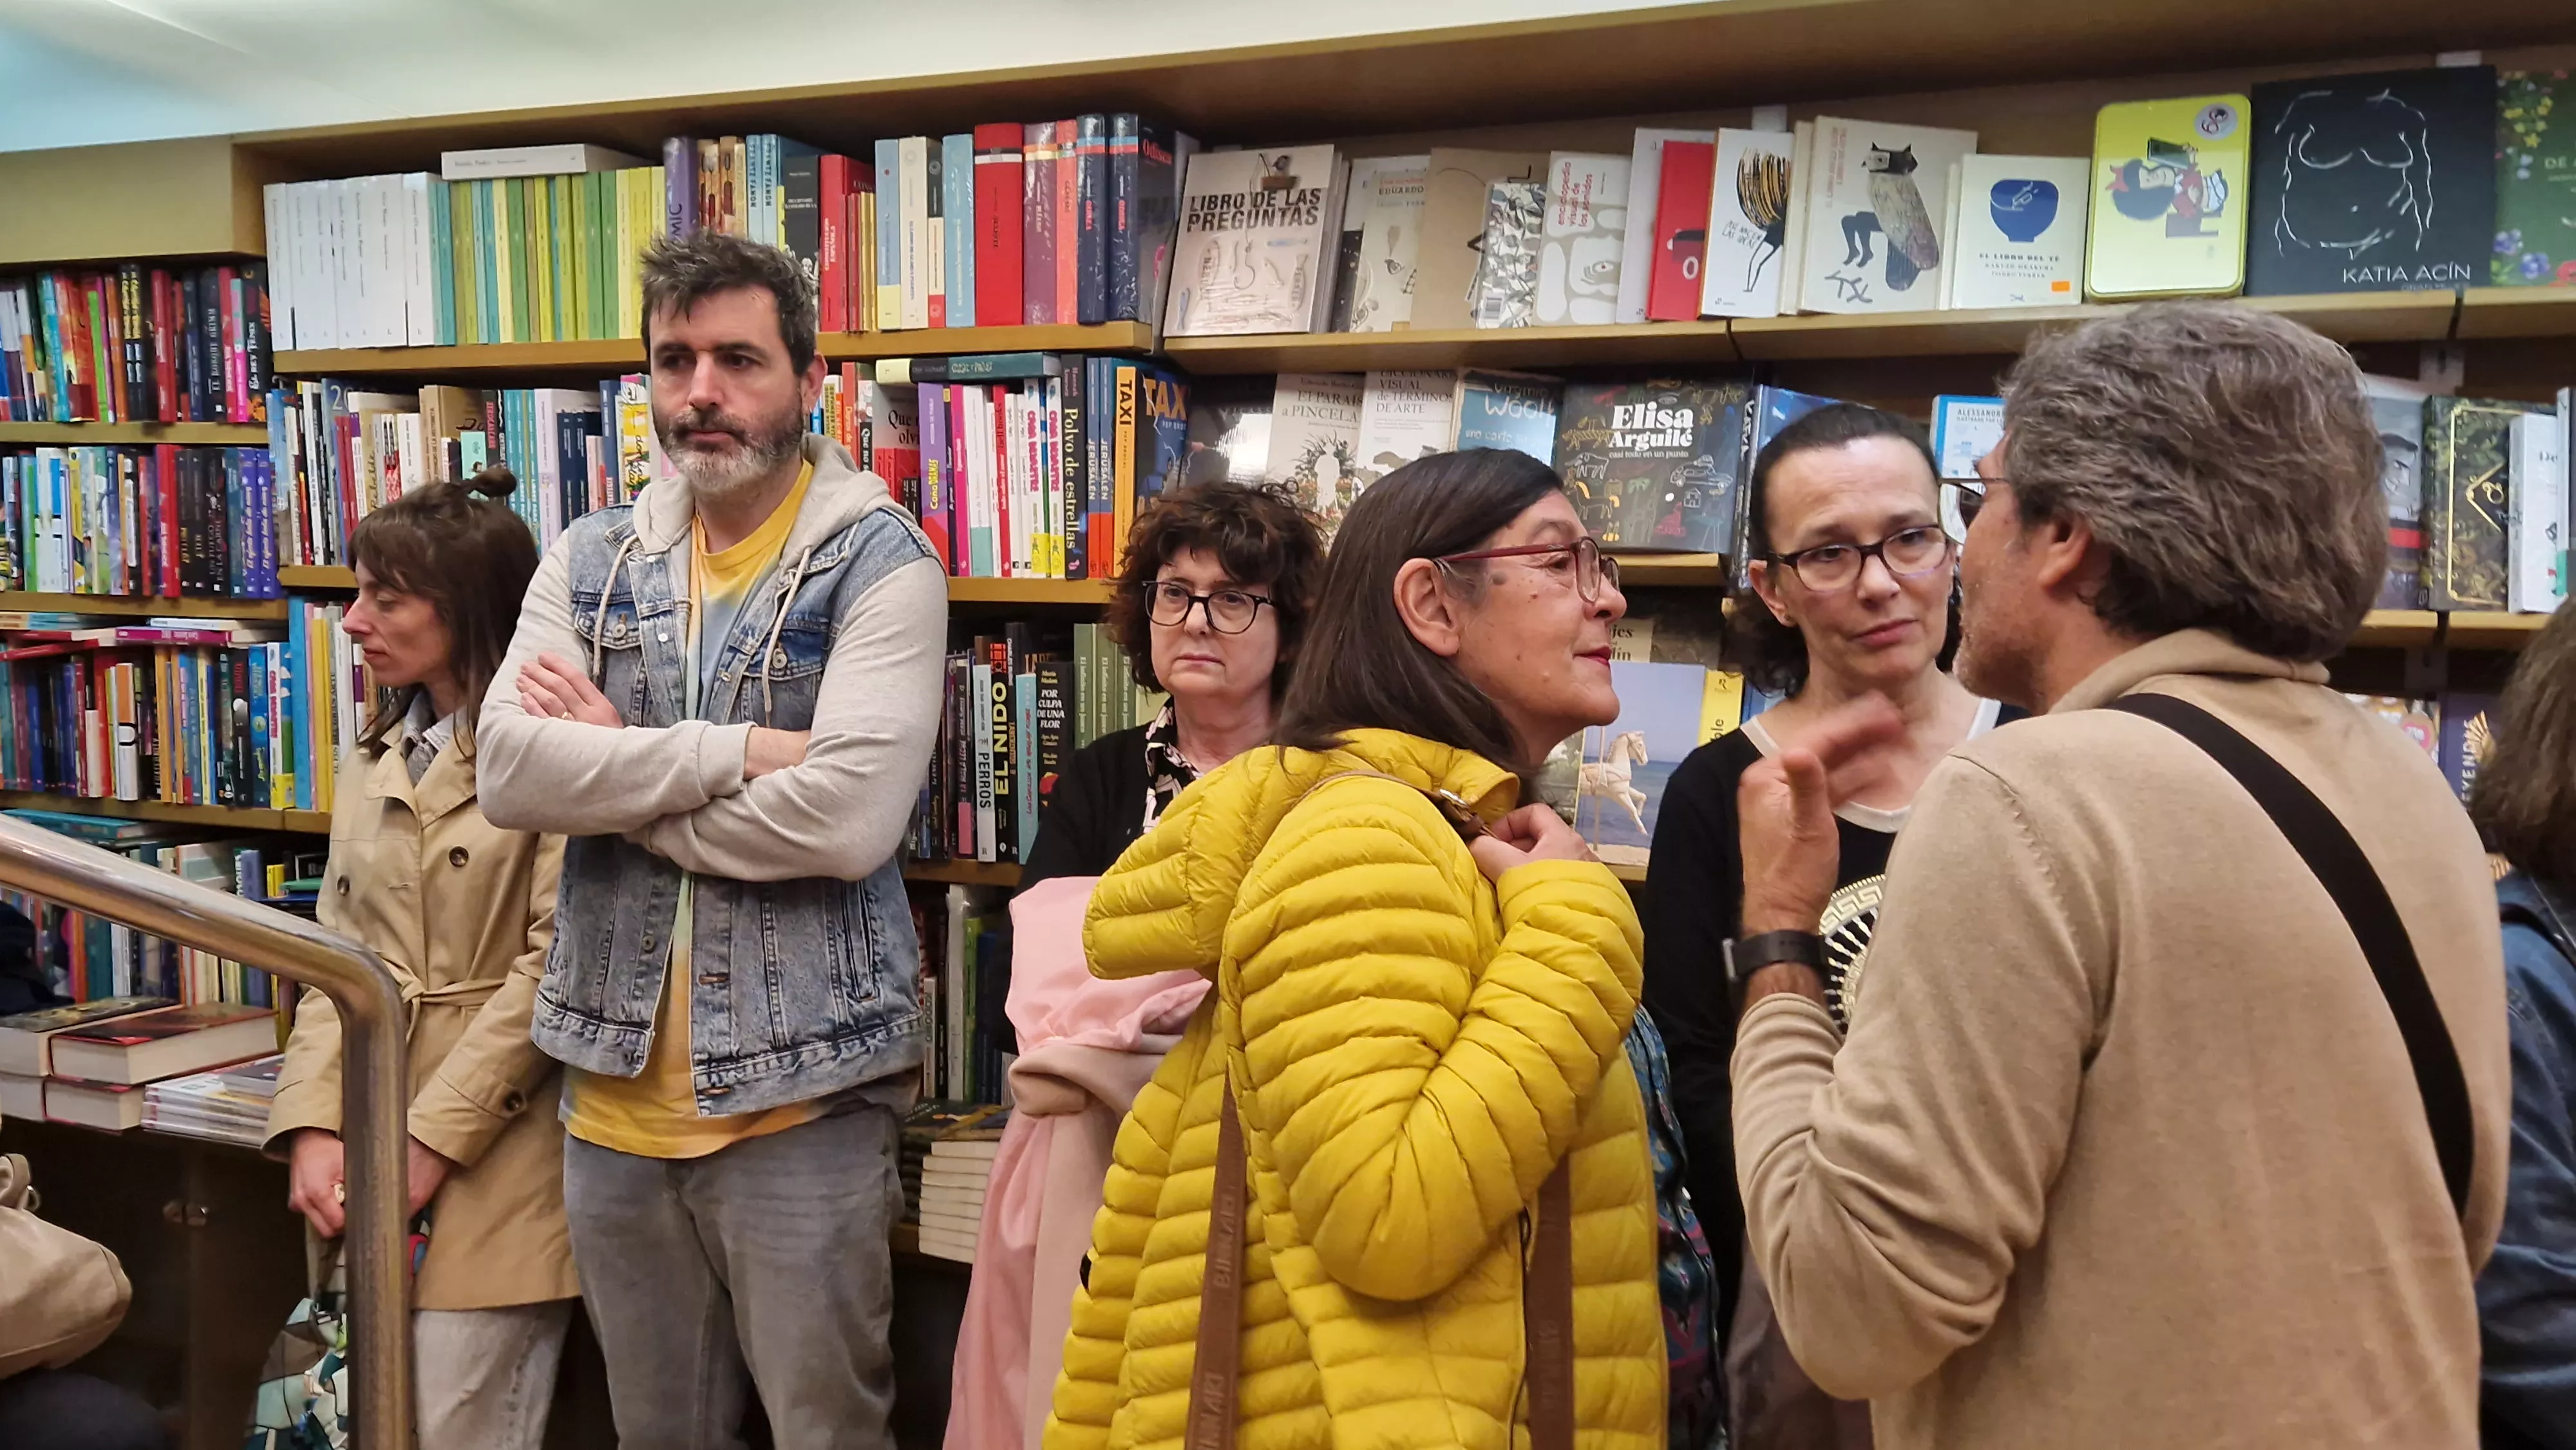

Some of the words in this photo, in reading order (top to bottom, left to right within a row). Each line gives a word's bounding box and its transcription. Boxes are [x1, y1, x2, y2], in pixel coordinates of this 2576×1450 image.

[749, 180, 758, 208] FANON
[764, 178, 773, 207] FANON
[1189, 193, 1246, 212] LIBRO
[1252, 191, 1277, 209] DE
[1284, 188, 1322, 207] LAS
[669, 203, 681, 237] MIC
[1186, 205, 1320, 233] PREGUNTAS
[2343, 265, 2409, 284] KATIA
[2415, 261, 2471, 282] ACÍN
[1379, 379, 1422, 390] VISUAL
[1119, 380, 1132, 426] TAXI
[1377, 391, 1390, 401] de
[1376, 402, 1390, 413] DE
[1392, 403, 1425, 414] ARTE
[1484, 393, 1555, 428] Woolf
[1611, 401, 1694, 429] Elisa
[1957, 408, 2001, 417] ALESSANDR
[887, 410, 911, 429] Que
[1064, 408, 1079, 451] Polvo
[860, 428, 871, 449] Que
[1607, 428, 1693, 451] Arguilé
[863, 450, 869, 463] no
[1609, 450, 1624, 458] casi
[1666, 450, 1689, 458] punto
[1065, 457, 1080, 477] de
[1087, 438, 1097, 500] JERUSALÉN
[1100, 438, 1110, 500] JERUSALÉN
[1065, 481, 1081, 550] estrellas
[1611, 625, 1634, 640] jes
[1123, 655, 1130, 664] El
[1611, 647, 1632, 662] dín
[1038, 699, 1062, 708] CULPA
[1041, 689, 1058, 698] POR
[1080, 692, 1086, 701] en
[1101, 693, 1107, 702] en
[1123, 692, 1129, 701] en
[992, 681, 1008, 752] NIDO
[1036, 710, 1046, 719] DE
[1046, 710, 1065, 719] UNA
[1080, 702, 1086, 711] un
[1102, 703, 1107, 712] un
[1123, 702, 1129, 712] un
[1039, 720, 1061, 729] FLOR
[1710, 719, 1725, 740] ble
[2462, 719, 2476, 804] EYENDS
[978, 752, 992, 809] PERROS
[994, 762, 1009, 795] EL
